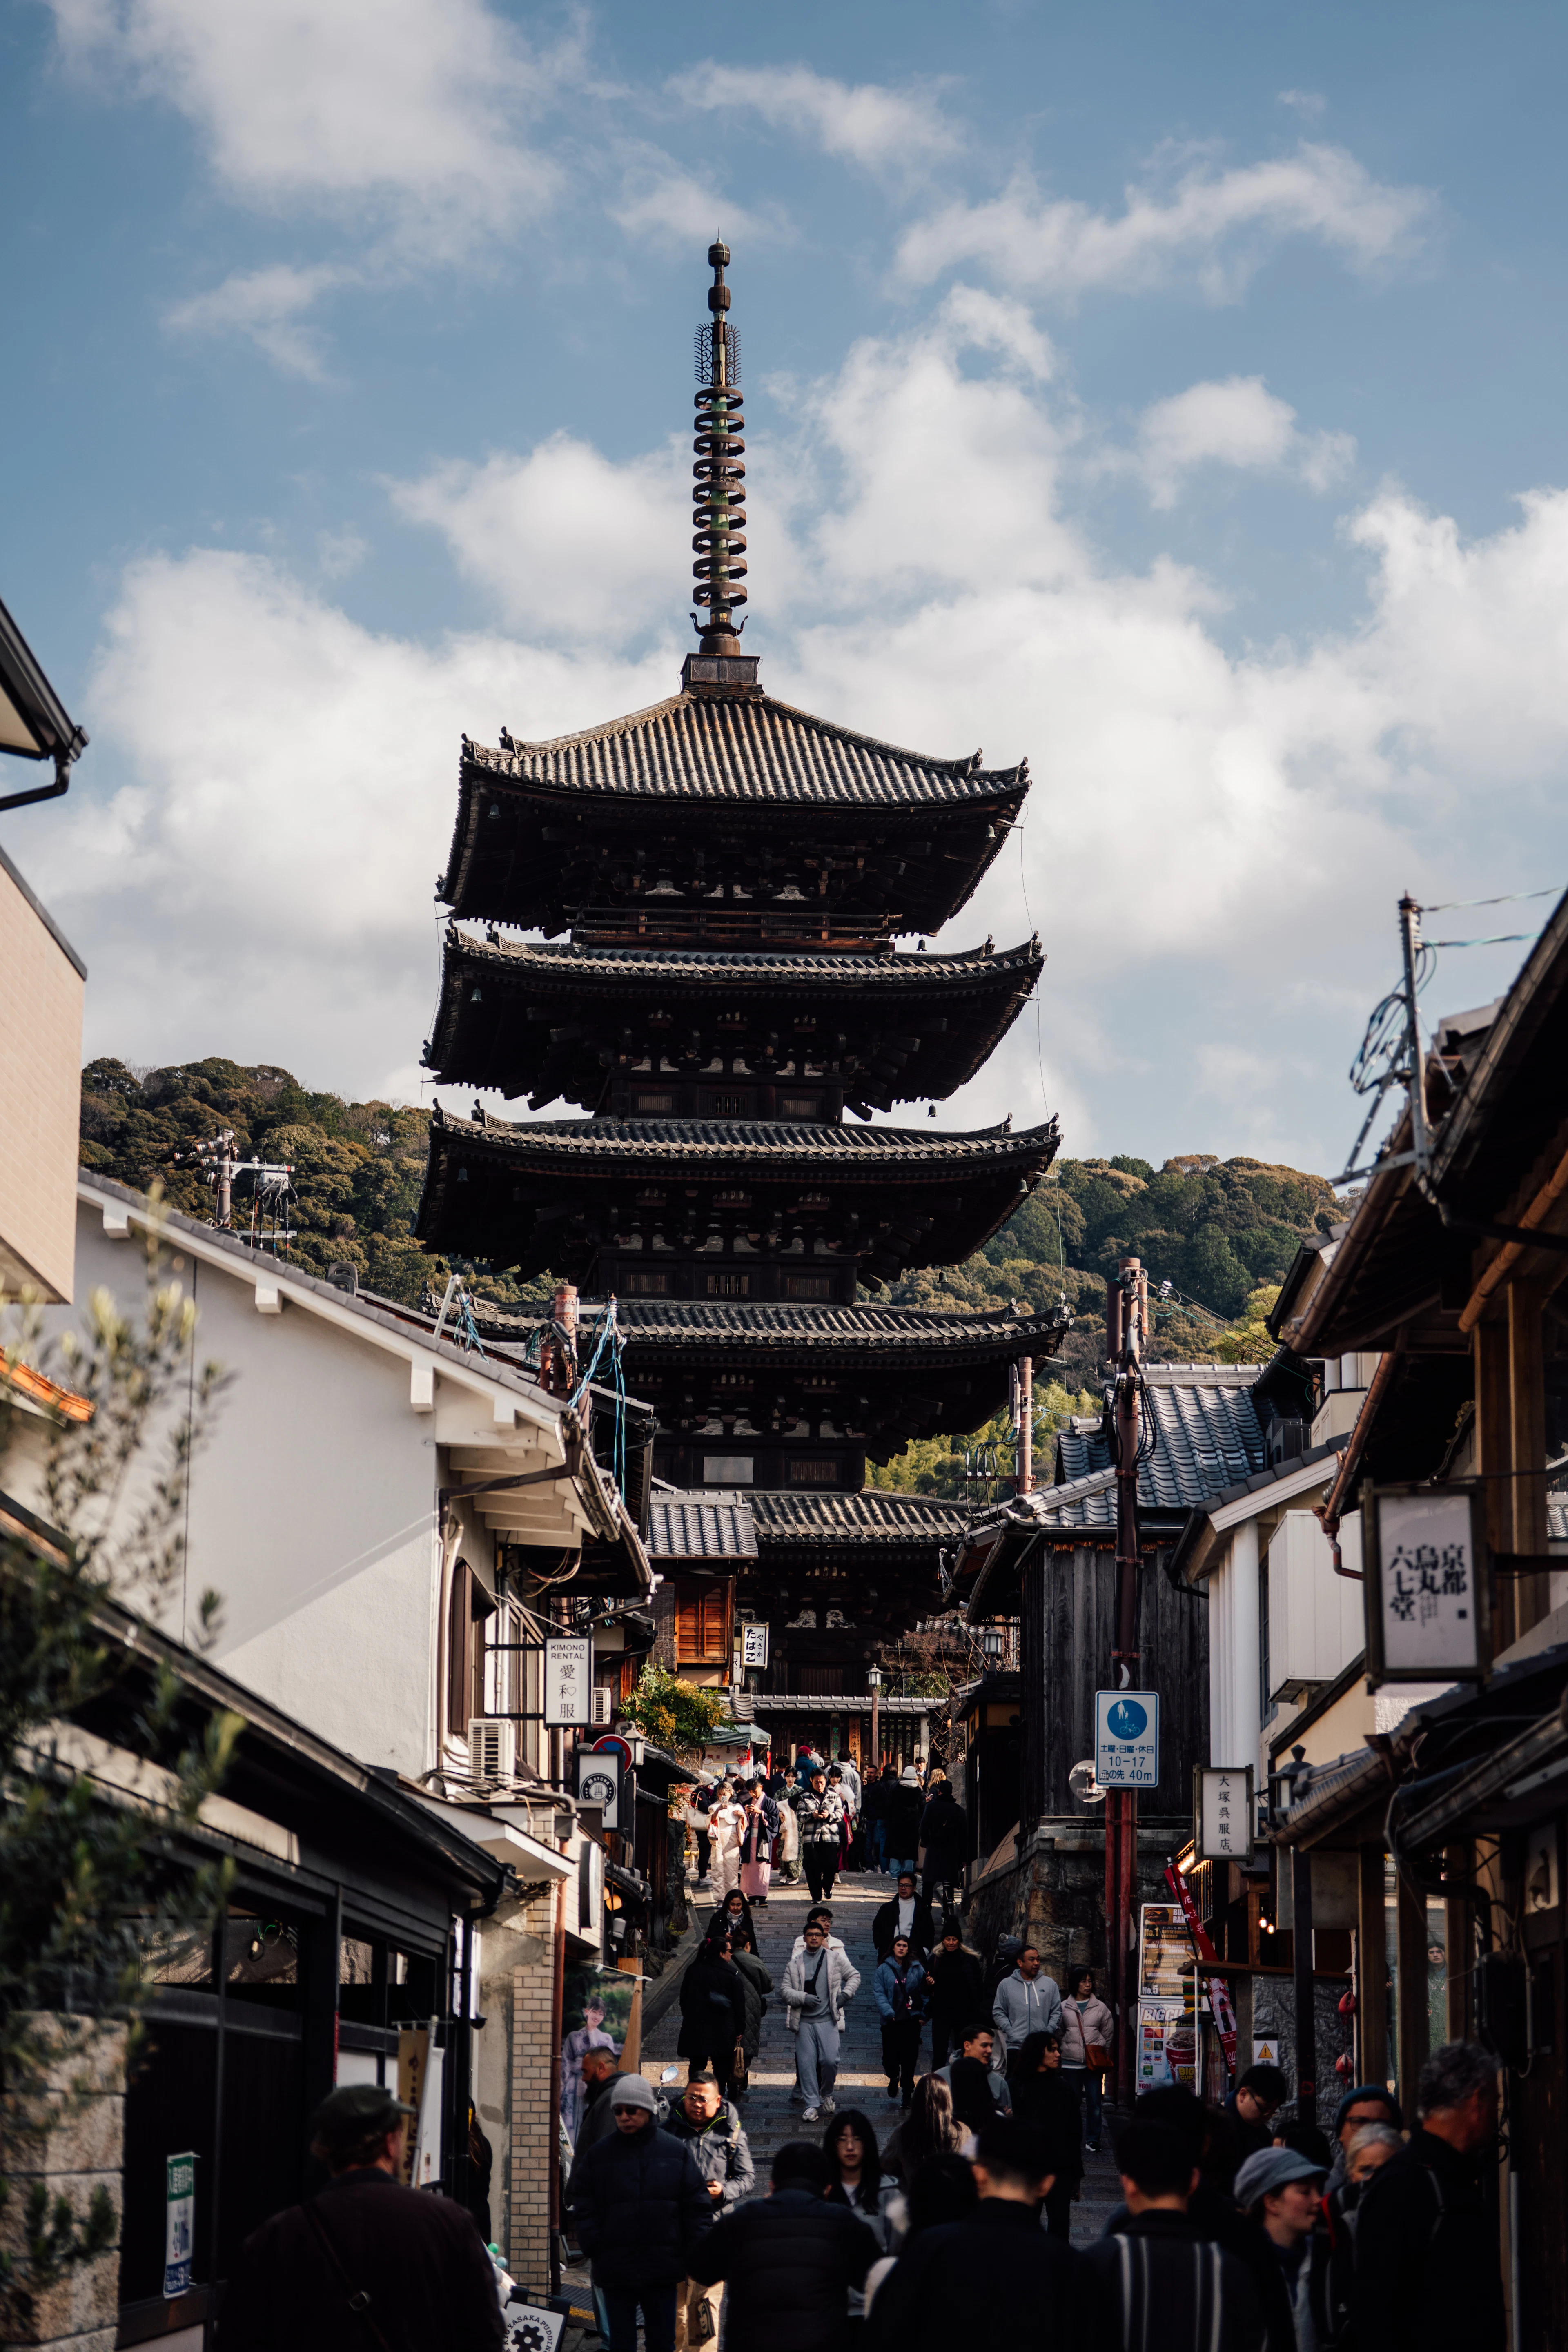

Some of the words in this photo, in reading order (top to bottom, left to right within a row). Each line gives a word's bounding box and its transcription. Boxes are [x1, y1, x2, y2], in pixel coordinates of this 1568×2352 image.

[1440, 1543, 1467, 1595] 京都
[1388, 1545, 1416, 1621] 六七堂
[746, 1628, 756, 1662] たばこ
[559, 1664, 576, 1719] 愛和服
[1100, 1745, 1154, 1754] 土曜・日曜・休日
[587, 1777, 610, 1785] MATCHA
[1129, 1770, 1152, 1780] 40m
[1218, 1776, 1230, 1851] 大塚呉服店
[1142, 1985, 1158, 1994] No.5
[1143, 2009, 1165, 2021] BIG
[1178, 2067, 1195, 2076] BIG
[507, 2314, 540, 2329] YASAKA
